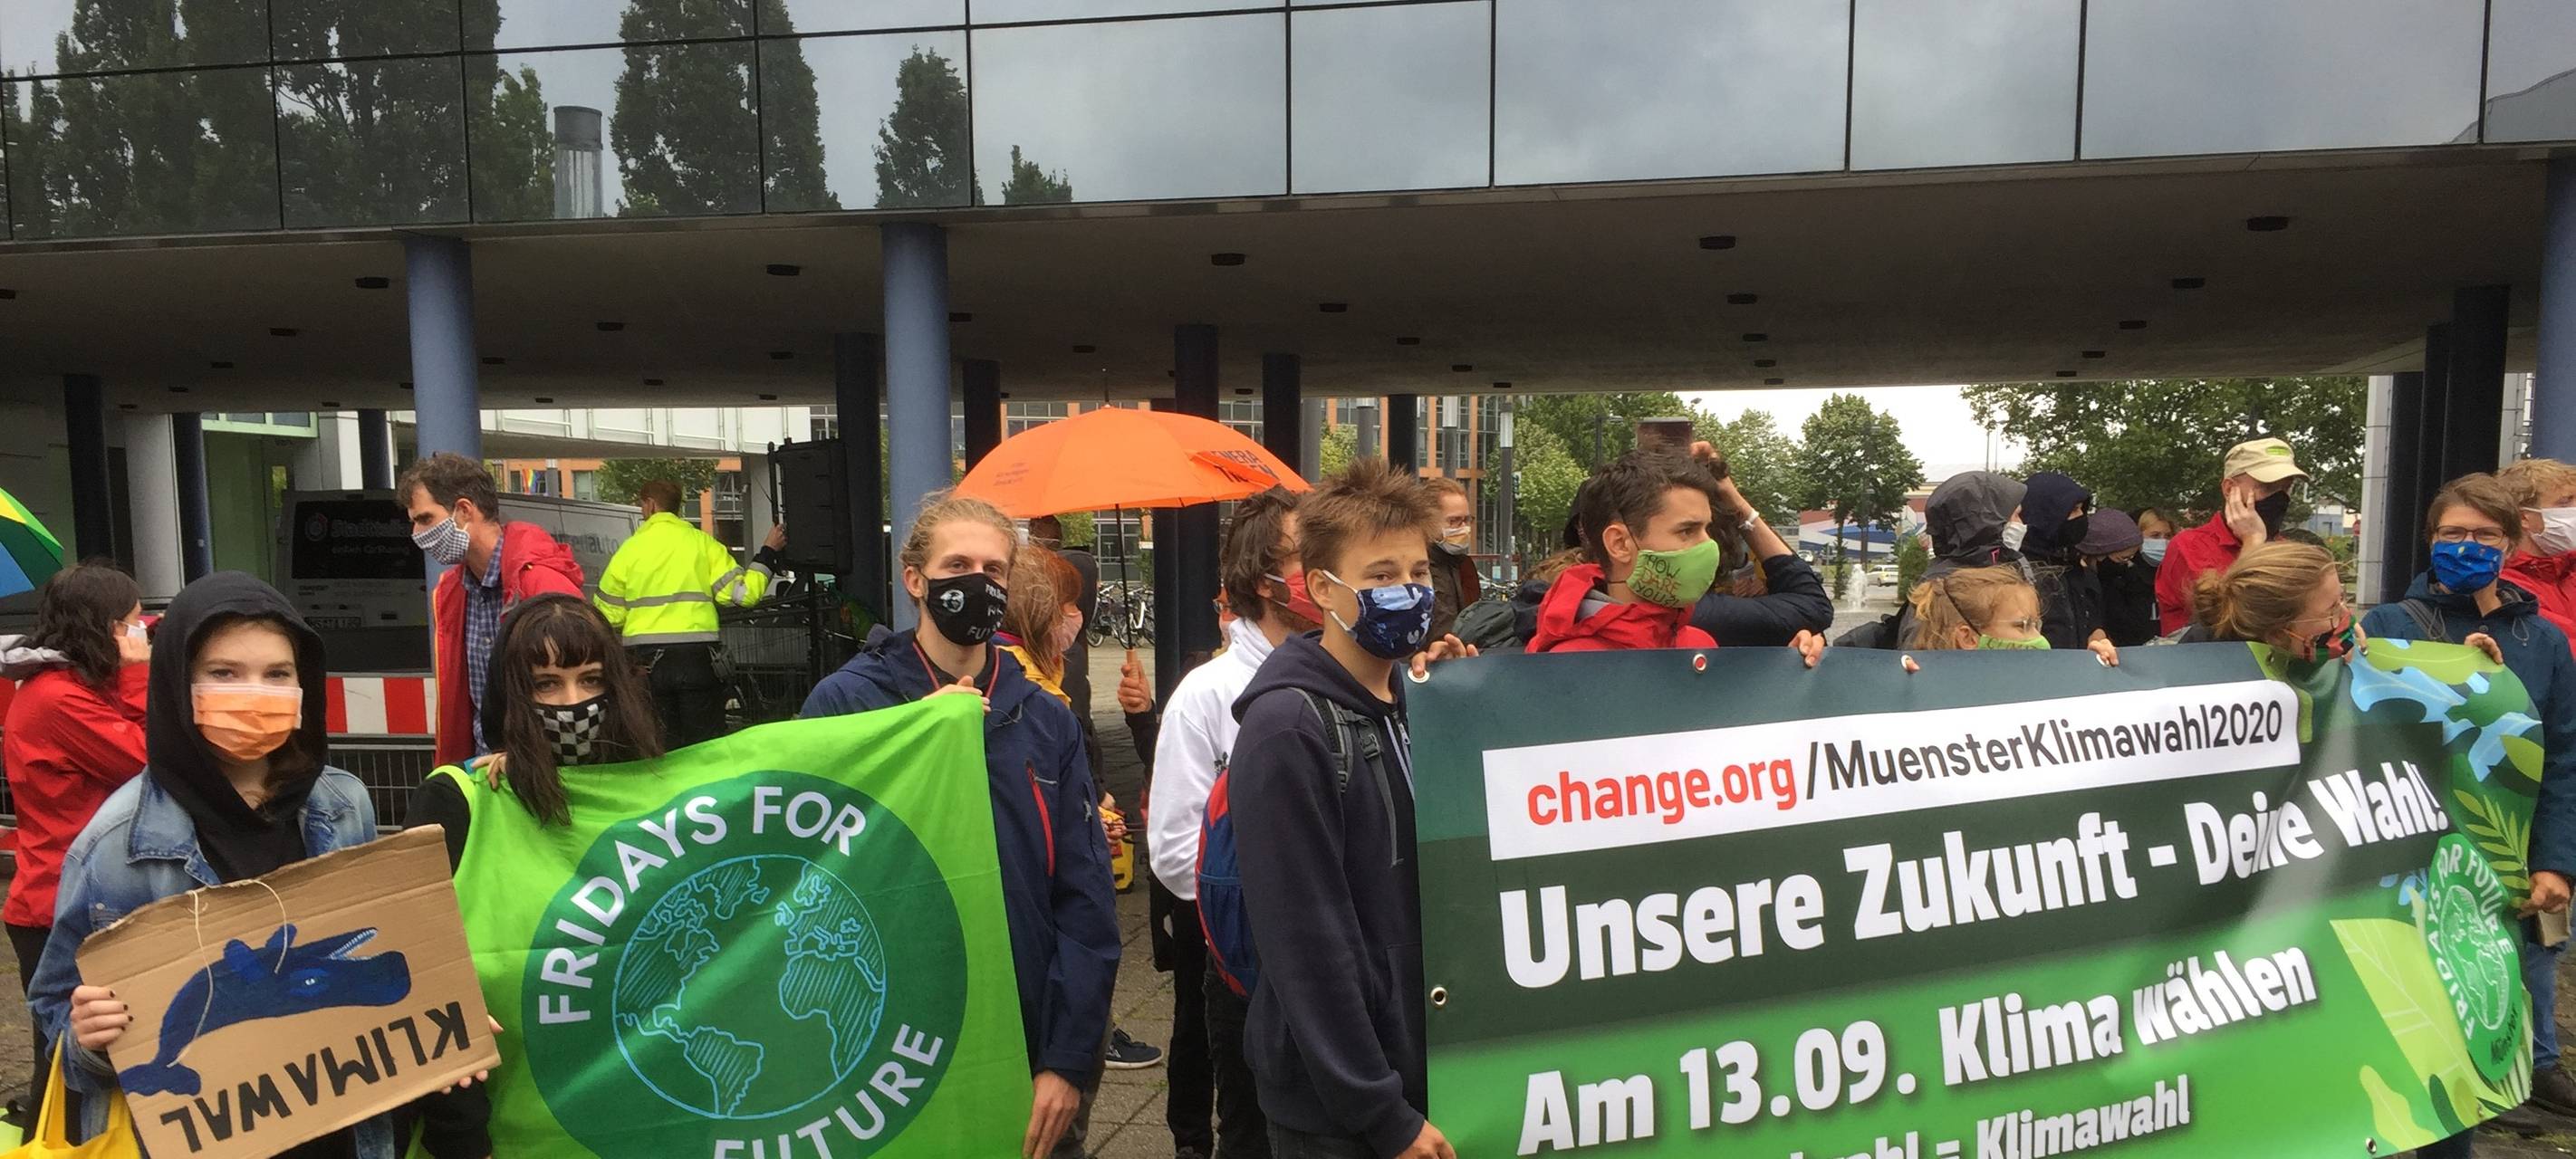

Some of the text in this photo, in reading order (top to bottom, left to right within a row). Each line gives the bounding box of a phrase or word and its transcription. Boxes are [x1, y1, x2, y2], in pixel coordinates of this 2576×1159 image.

[1644, 554, 1681, 579] HOW
[537, 785, 867, 1025] FRIDAYS FOR
[1499, 873, 1825, 989] Unsere
[1842, 811, 2138, 941] Zukunft
[2307, 761, 2449, 848] Wahl!
[160, 1001, 471, 1154] KLIMAWAL
[712, 1024, 944, 1159] FUTURE
[1516, 946, 2317, 1156] Am 13.09. Klima wählen
[1976, 1074, 2191, 1159] Klimawahl
